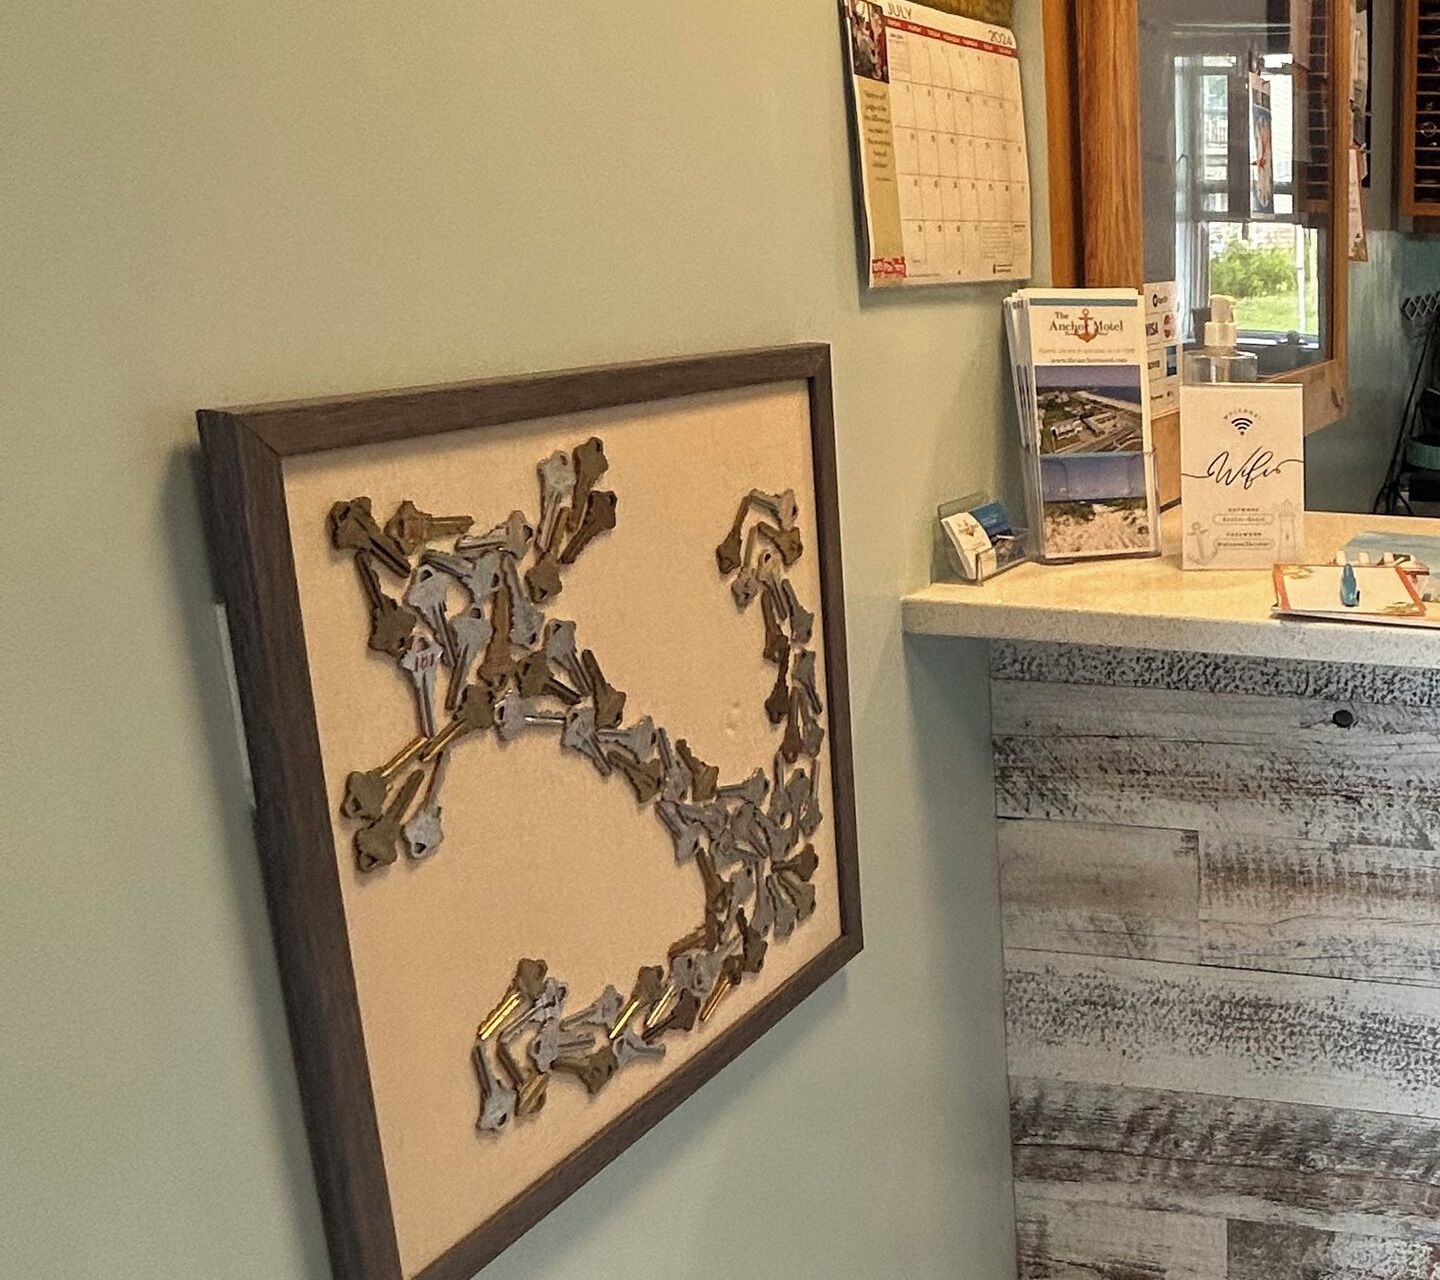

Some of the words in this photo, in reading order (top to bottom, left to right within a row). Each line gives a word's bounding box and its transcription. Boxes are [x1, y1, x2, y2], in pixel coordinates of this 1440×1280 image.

[887, 2, 912, 20] JULY
[987, 29, 1013, 47] 2024
[1054, 311, 1069, 320] The
[1049, 320, 1091, 332] Anchor
[1094, 320, 1124, 332] Motel
